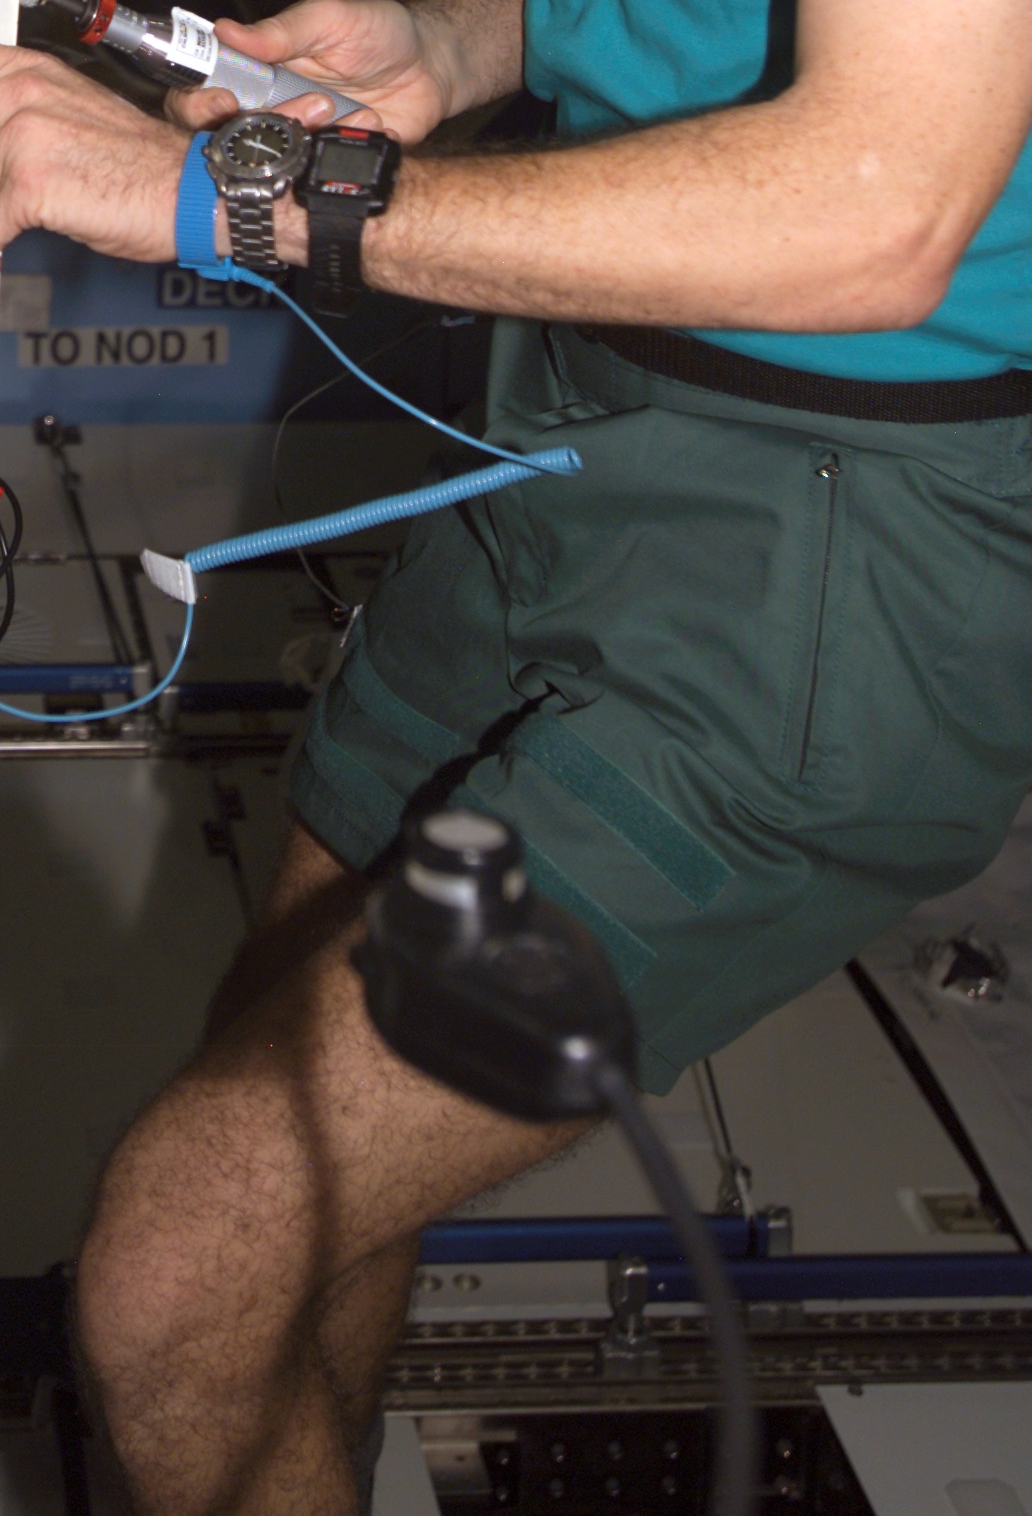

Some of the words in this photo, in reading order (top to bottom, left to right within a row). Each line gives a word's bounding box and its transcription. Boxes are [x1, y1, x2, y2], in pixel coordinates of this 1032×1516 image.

[24, 331, 80, 365] TO
[95, 330, 186, 365] NOD
[201, 331, 217, 364] 1
